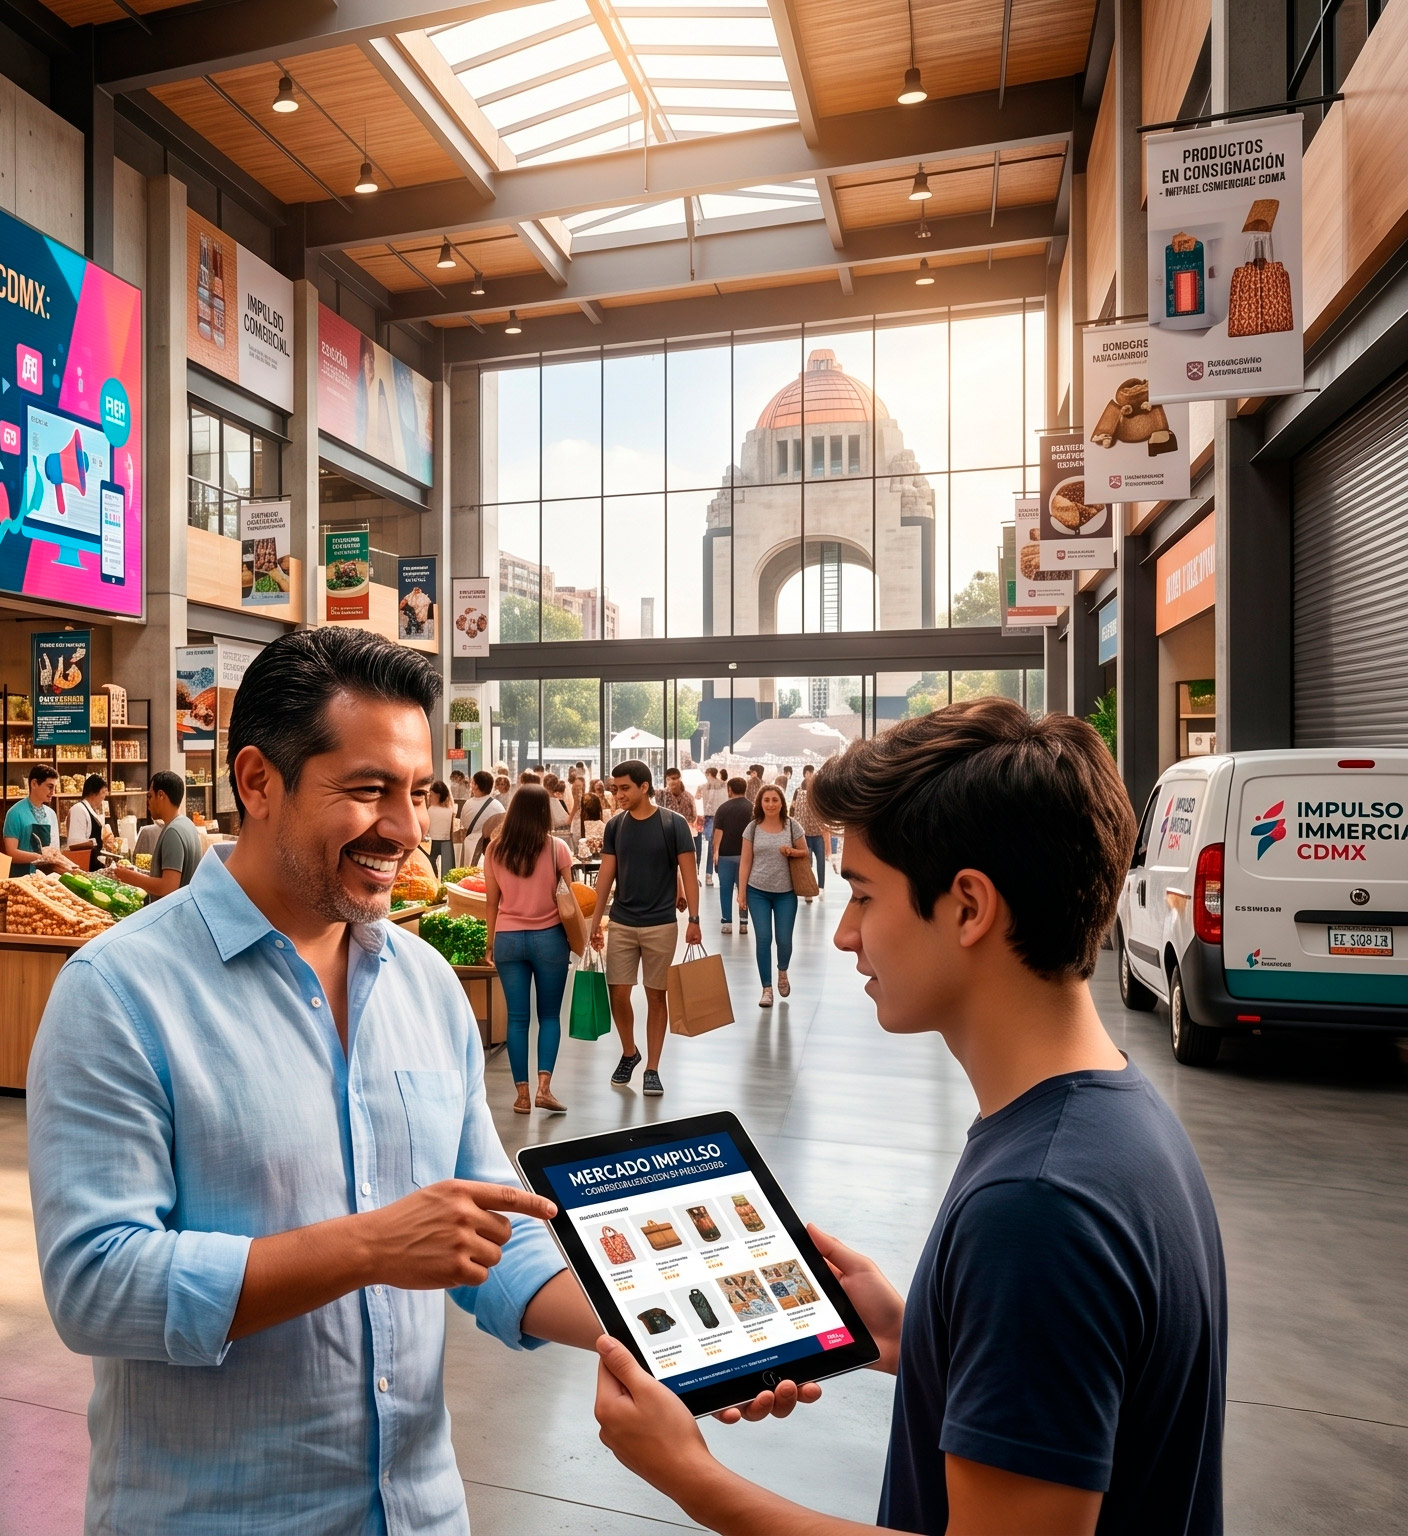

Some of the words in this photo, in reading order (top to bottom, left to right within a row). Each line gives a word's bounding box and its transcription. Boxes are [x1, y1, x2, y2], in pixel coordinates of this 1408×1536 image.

[1182, 138, 1264, 164] PRODUCTOS
[1161, 168, 1180, 185] EN
[1183, 151, 1285, 182] CONSIGNACIÓN
[1297, 801, 1404, 819] IMPULSO
[1296, 843, 1367, 861] CDMX
[568, 1157, 651, 1188] MERCADO
[651, 1143, 722, 1170] IMPULSO
